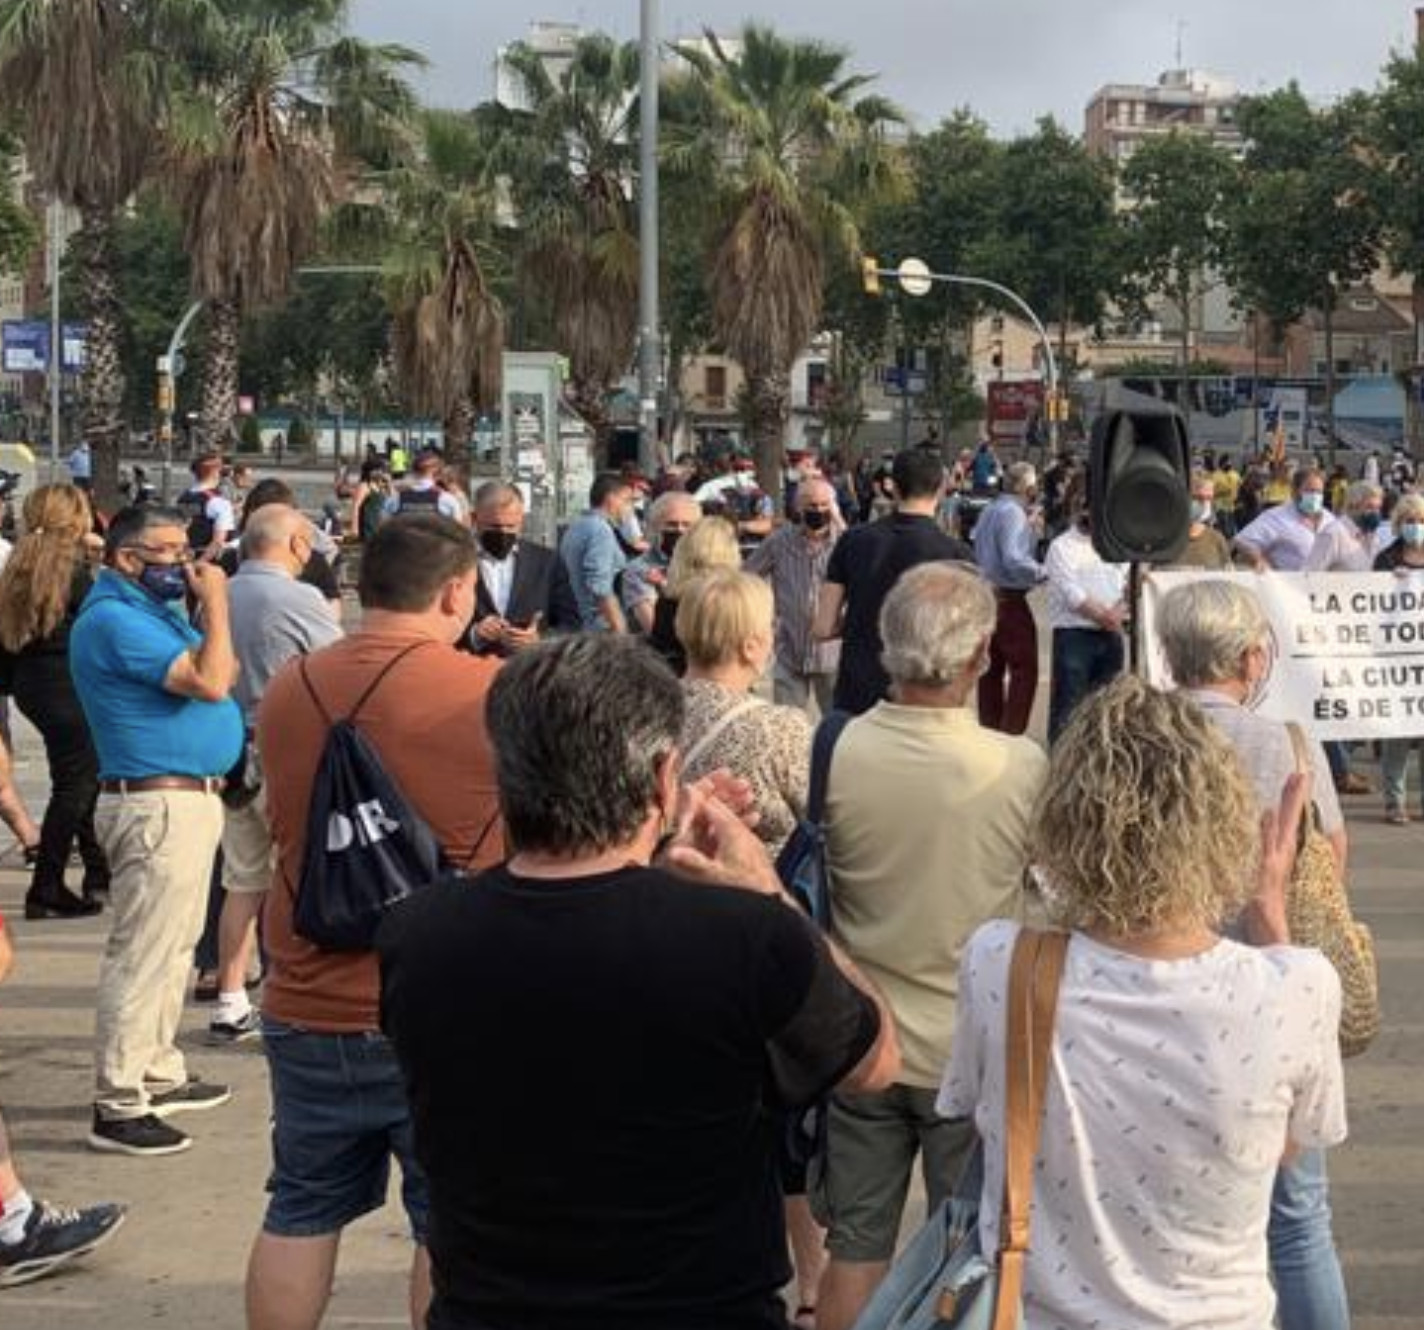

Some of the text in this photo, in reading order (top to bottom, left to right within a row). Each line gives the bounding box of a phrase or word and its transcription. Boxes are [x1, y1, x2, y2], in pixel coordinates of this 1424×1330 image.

[1309, 591, 1342, 613] LA
[1337, 624, 1372, 644] DE
[1322, 667, 1354, 688] LA
[1313, 694, 1348, 720] ÉS
[1358, 698, 1392, 719] DE
